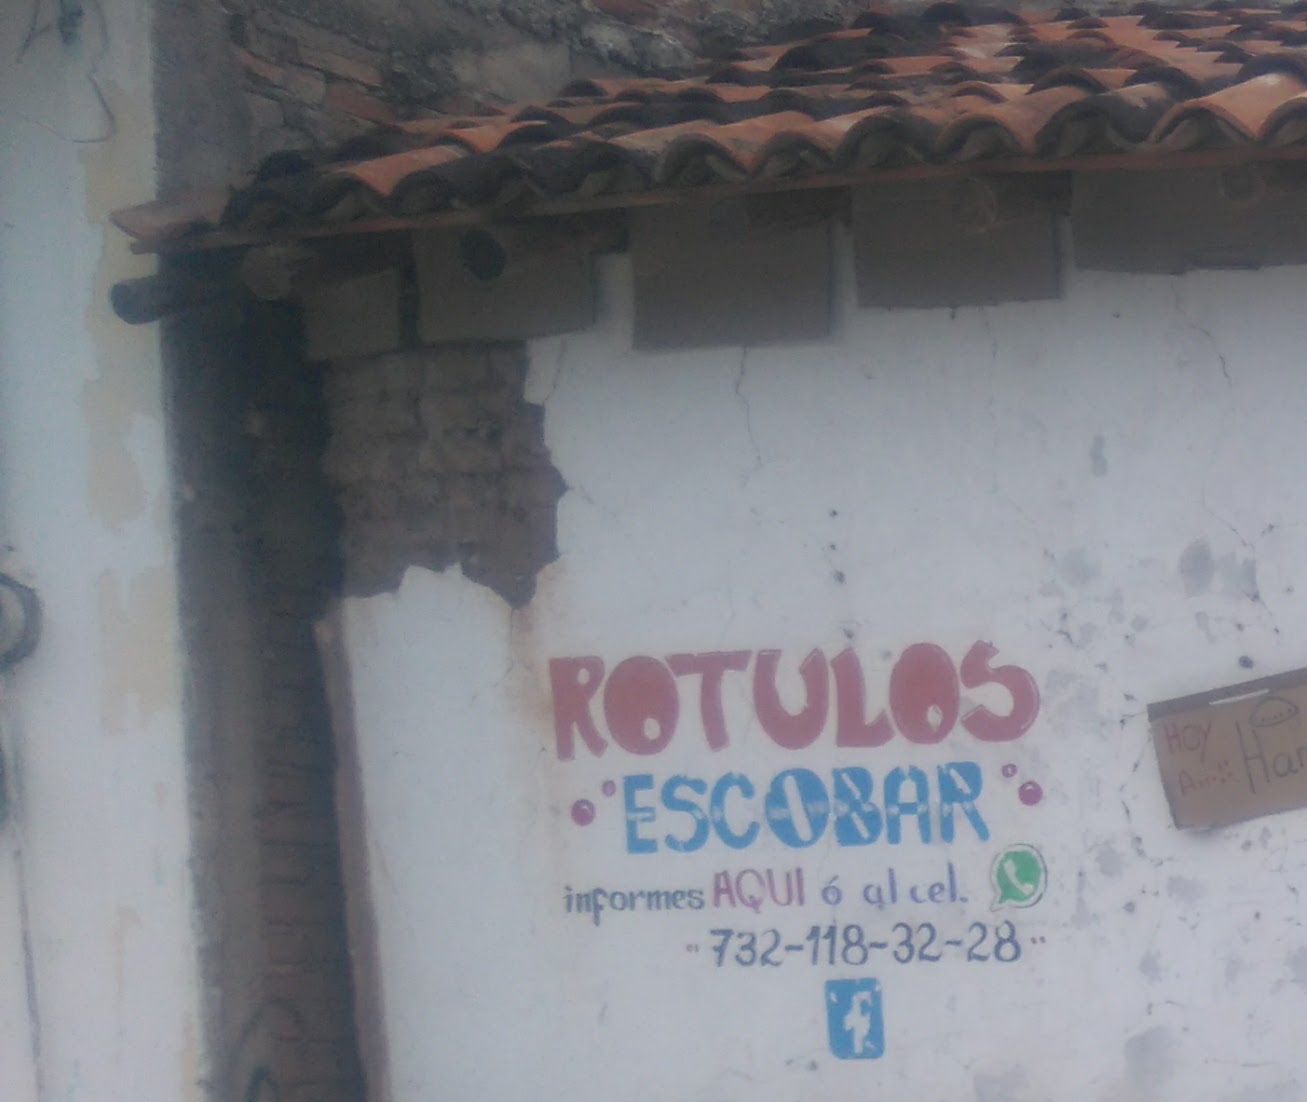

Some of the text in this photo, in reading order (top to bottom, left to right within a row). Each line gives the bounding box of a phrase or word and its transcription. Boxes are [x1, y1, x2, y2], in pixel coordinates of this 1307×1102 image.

[548, 639, 1041, 762] ROTULOS
[622, 760, 991, 855] ESCOBAR
[562, 884, 705, 927] informes
[711, 867, 807, 914] AQUI
[863, 867, 898, 906] al
[707, 918, 1023, 969] 732-118-32-28
